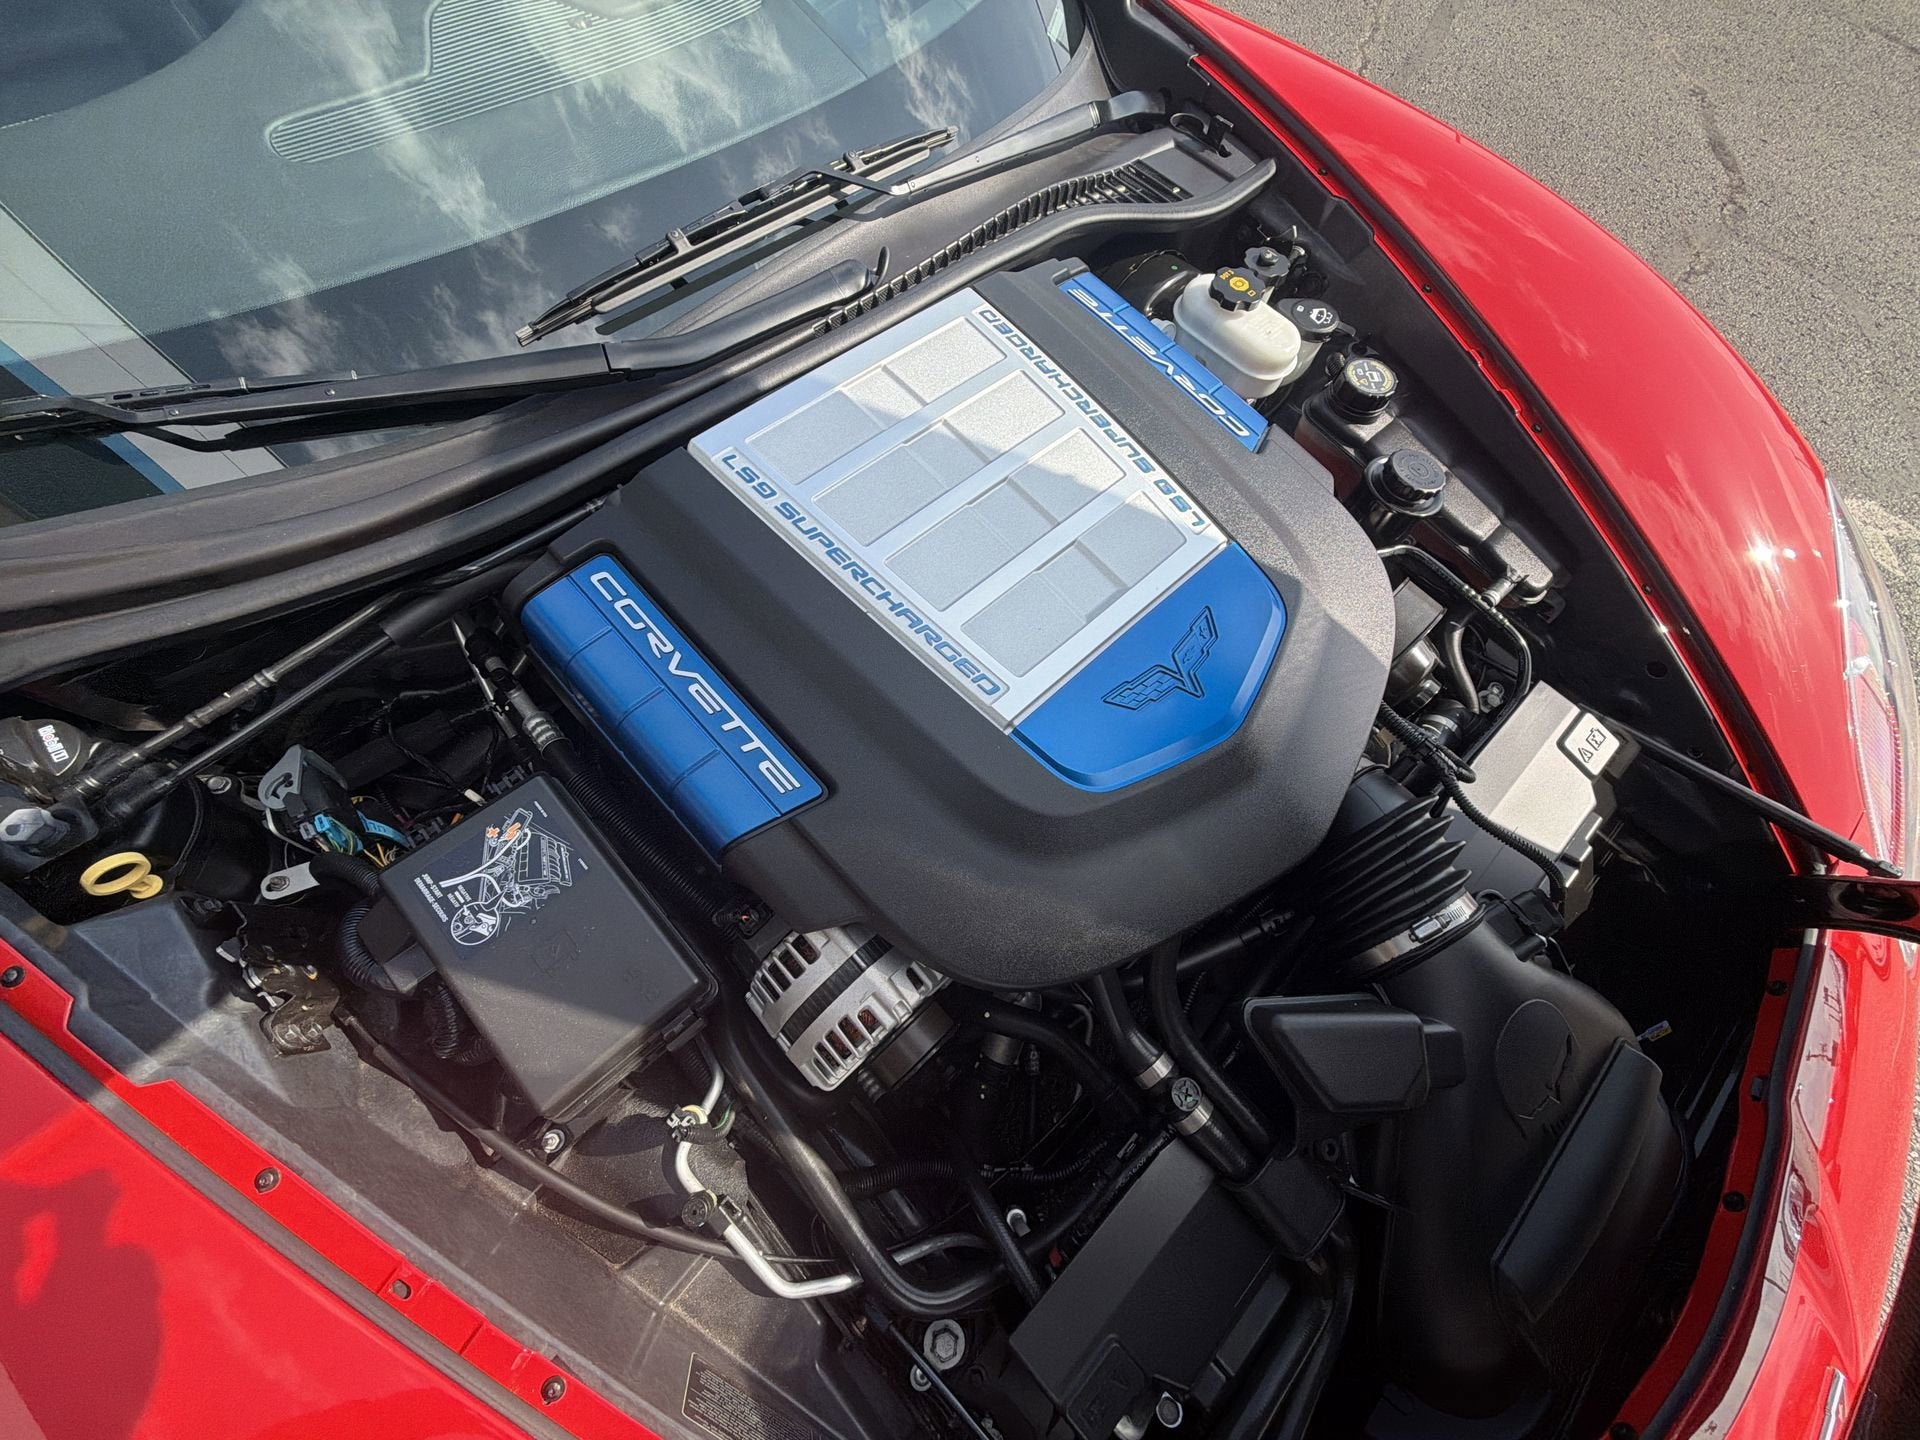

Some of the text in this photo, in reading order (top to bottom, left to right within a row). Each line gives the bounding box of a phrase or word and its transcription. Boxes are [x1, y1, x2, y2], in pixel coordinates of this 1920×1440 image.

[978, 309, 1206, 526] LS9 SUPERCHARGED
[1066, 288, 1250, 437] CORVETTE
[590, 571, 801, 794] CORVETTE
[722, 454, 1001, 696] LS9 SUPERCHARGED
[37, 724, 64, 753] Mobil
